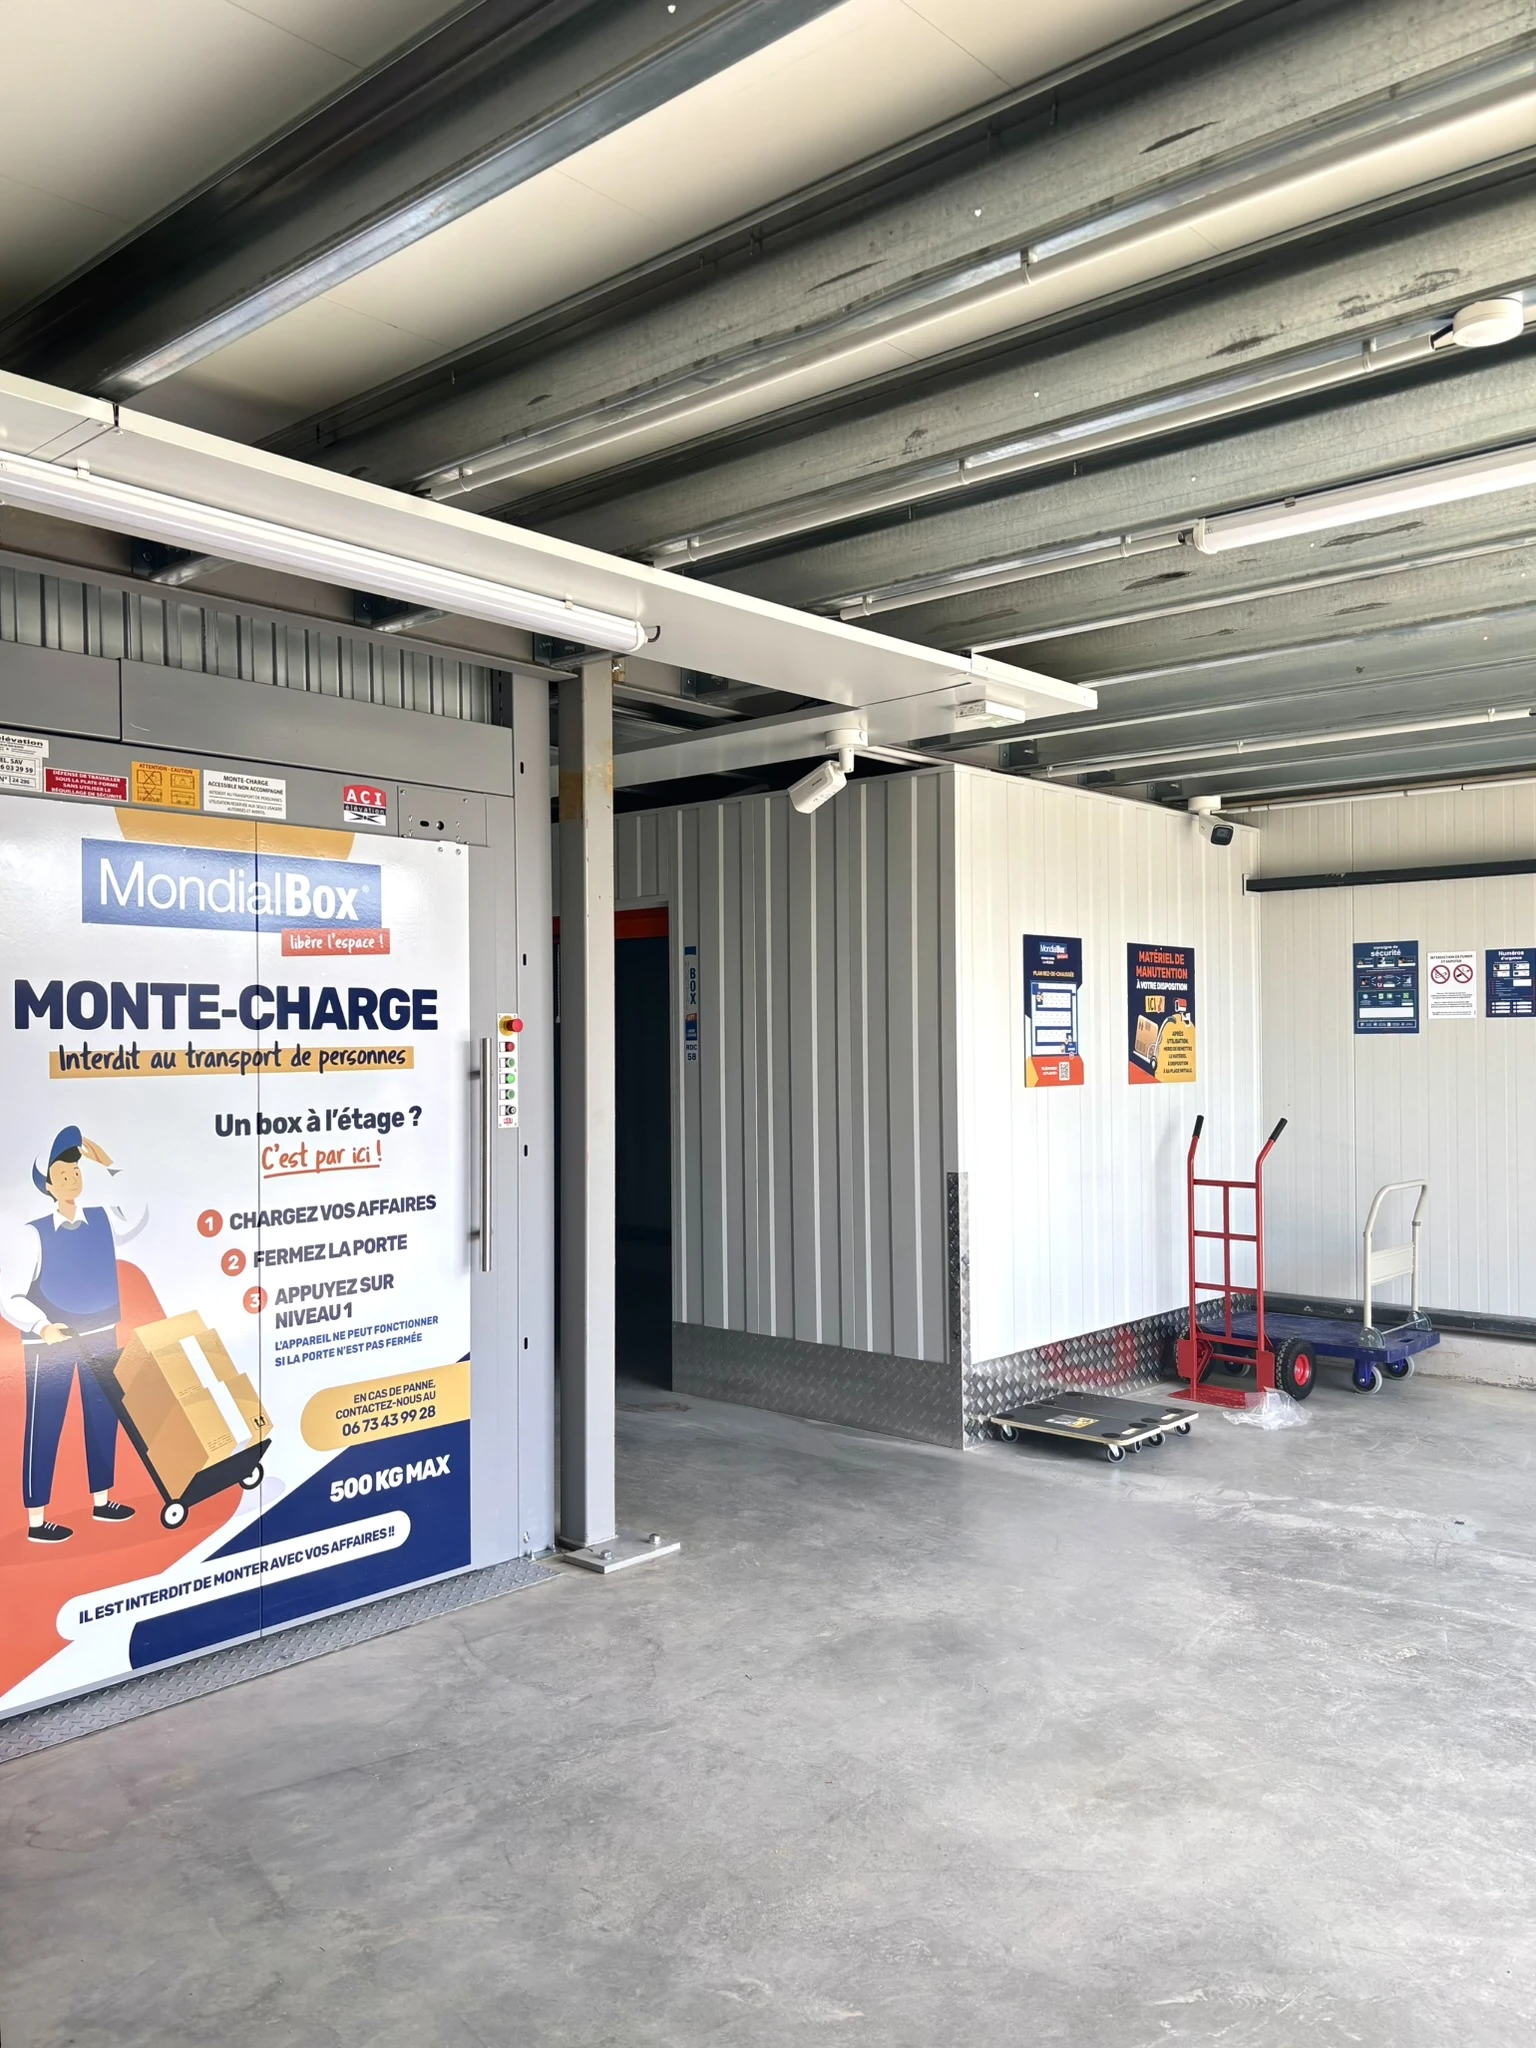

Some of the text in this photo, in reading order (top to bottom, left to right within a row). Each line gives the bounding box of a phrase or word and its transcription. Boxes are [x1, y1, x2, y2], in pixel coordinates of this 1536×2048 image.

[0, 735, 43, 747] lévation
[10, 758, 23, 766] SAV
[138, 763, 166, 772] ATTENTION
[171, 766, 193, 774] CAUTION
[80, 784, 104, 792] UTILISER
[88, 774, 120, 782] TRAVAILLER
[208, 781, 237, 790] ACCESSIBLE
[346, 788, 382, 806] ACI
[290, 932, 384, 952] libère l'espace !
[1370, 949, 1402, 957] sécurité
[1138, 949, 1184, 965] MATÉRIEL DE
[1136, 965, 1188, 980] MANUTENTION
[1140, 980, 1156, 990] VOTRE
[1156, 982, 1188, 992] DISPOSITION
[14, 979, 438, 1031] MONTE-CHARGE
[59, 1041, 406, 1075] Interdit au transport de personnes
[688, 1052, 696, 1060] 58
[215, 1105, 423, 1136] Un box à l'étage ?
[262, 1140, 382, 1173] C'est par ici !
[229, 1206, 318, 1230] CHARGEZ
[320, 1202, 356, 1221] VOS
[357, 1194, 437, 1218] AFFAIRES
[228, 1234, 408, 1270] 2 FERMEZ LA PORTE
[249, 1273, 394, 1308] 3 APPUYEZ SUR
[276, 1302, 353, 1330] NIVEAU 1
[275, 1315, 439, 1352] L'APPAREIL NE PEUT FONCTIONNER
[275, 1332, 422, 1367] SI LA PORTE N'EST PAS FERMÉE
[354, 1379, 436, 1404] EN CAS DE PANNE,
[335, 1390, 436, 1420] CONTACTEZ-NOUS AU
[342, 1405, 436, 1436] 06 73 43 99 28
[330, 1454, 451, 1503] 500 KG MAX
[79, 1526, 395, 1624] IL EST INTERDIT DE MONTER AVEC VOS AFFAIRES !!
